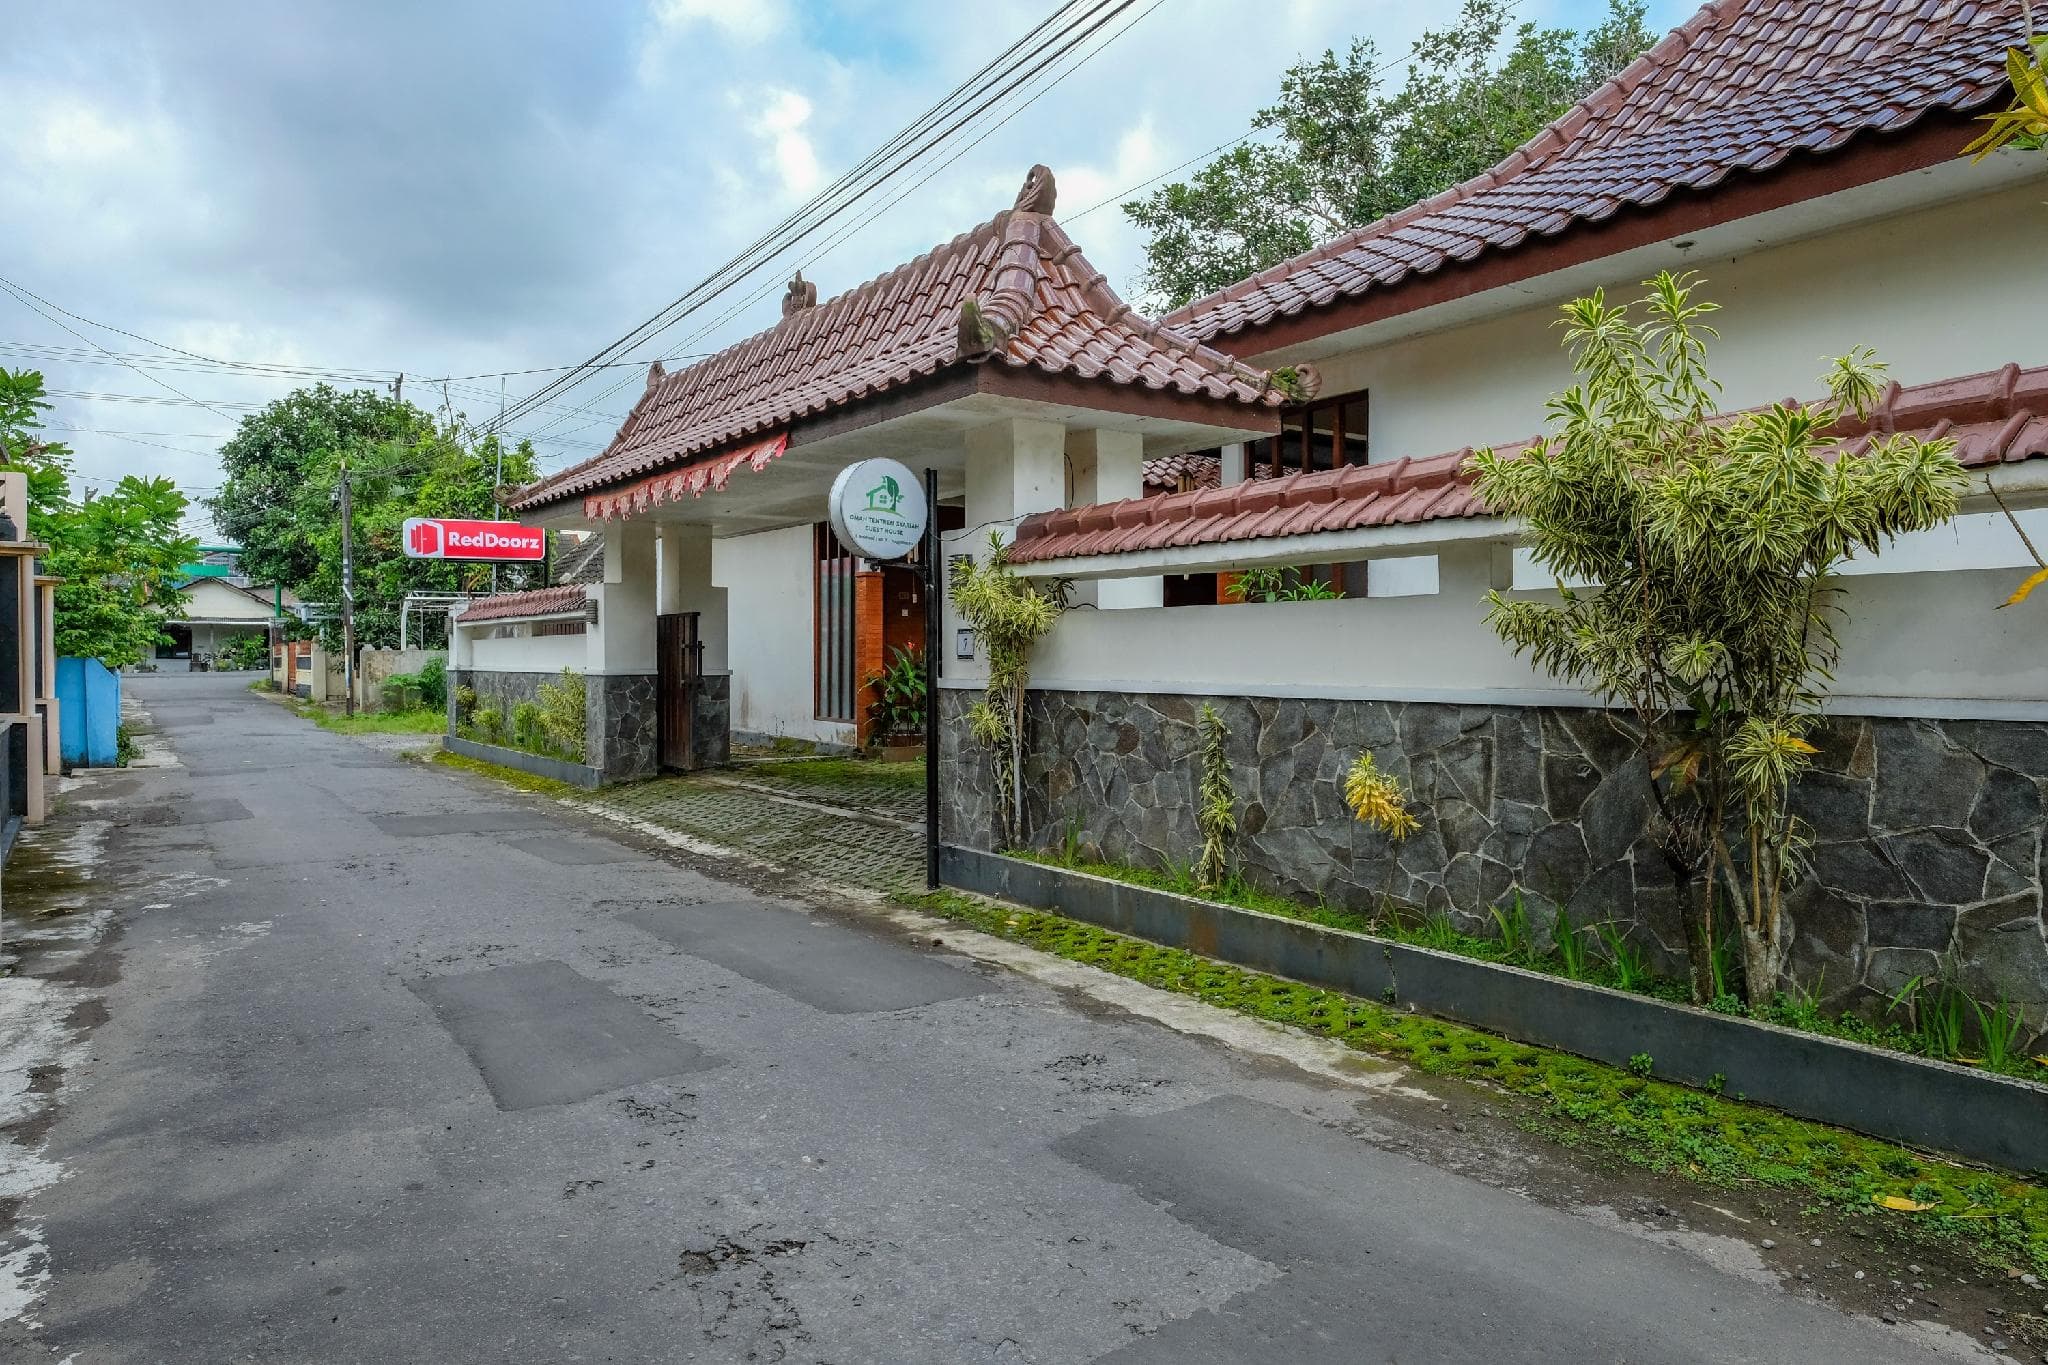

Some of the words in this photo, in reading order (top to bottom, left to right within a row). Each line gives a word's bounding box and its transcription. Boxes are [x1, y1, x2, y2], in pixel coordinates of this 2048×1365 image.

[865, 525, 884, 533] GUEST
[885, 528, 904, 536] HOUSE
[448, 531, 540, 549] RedDoorz
